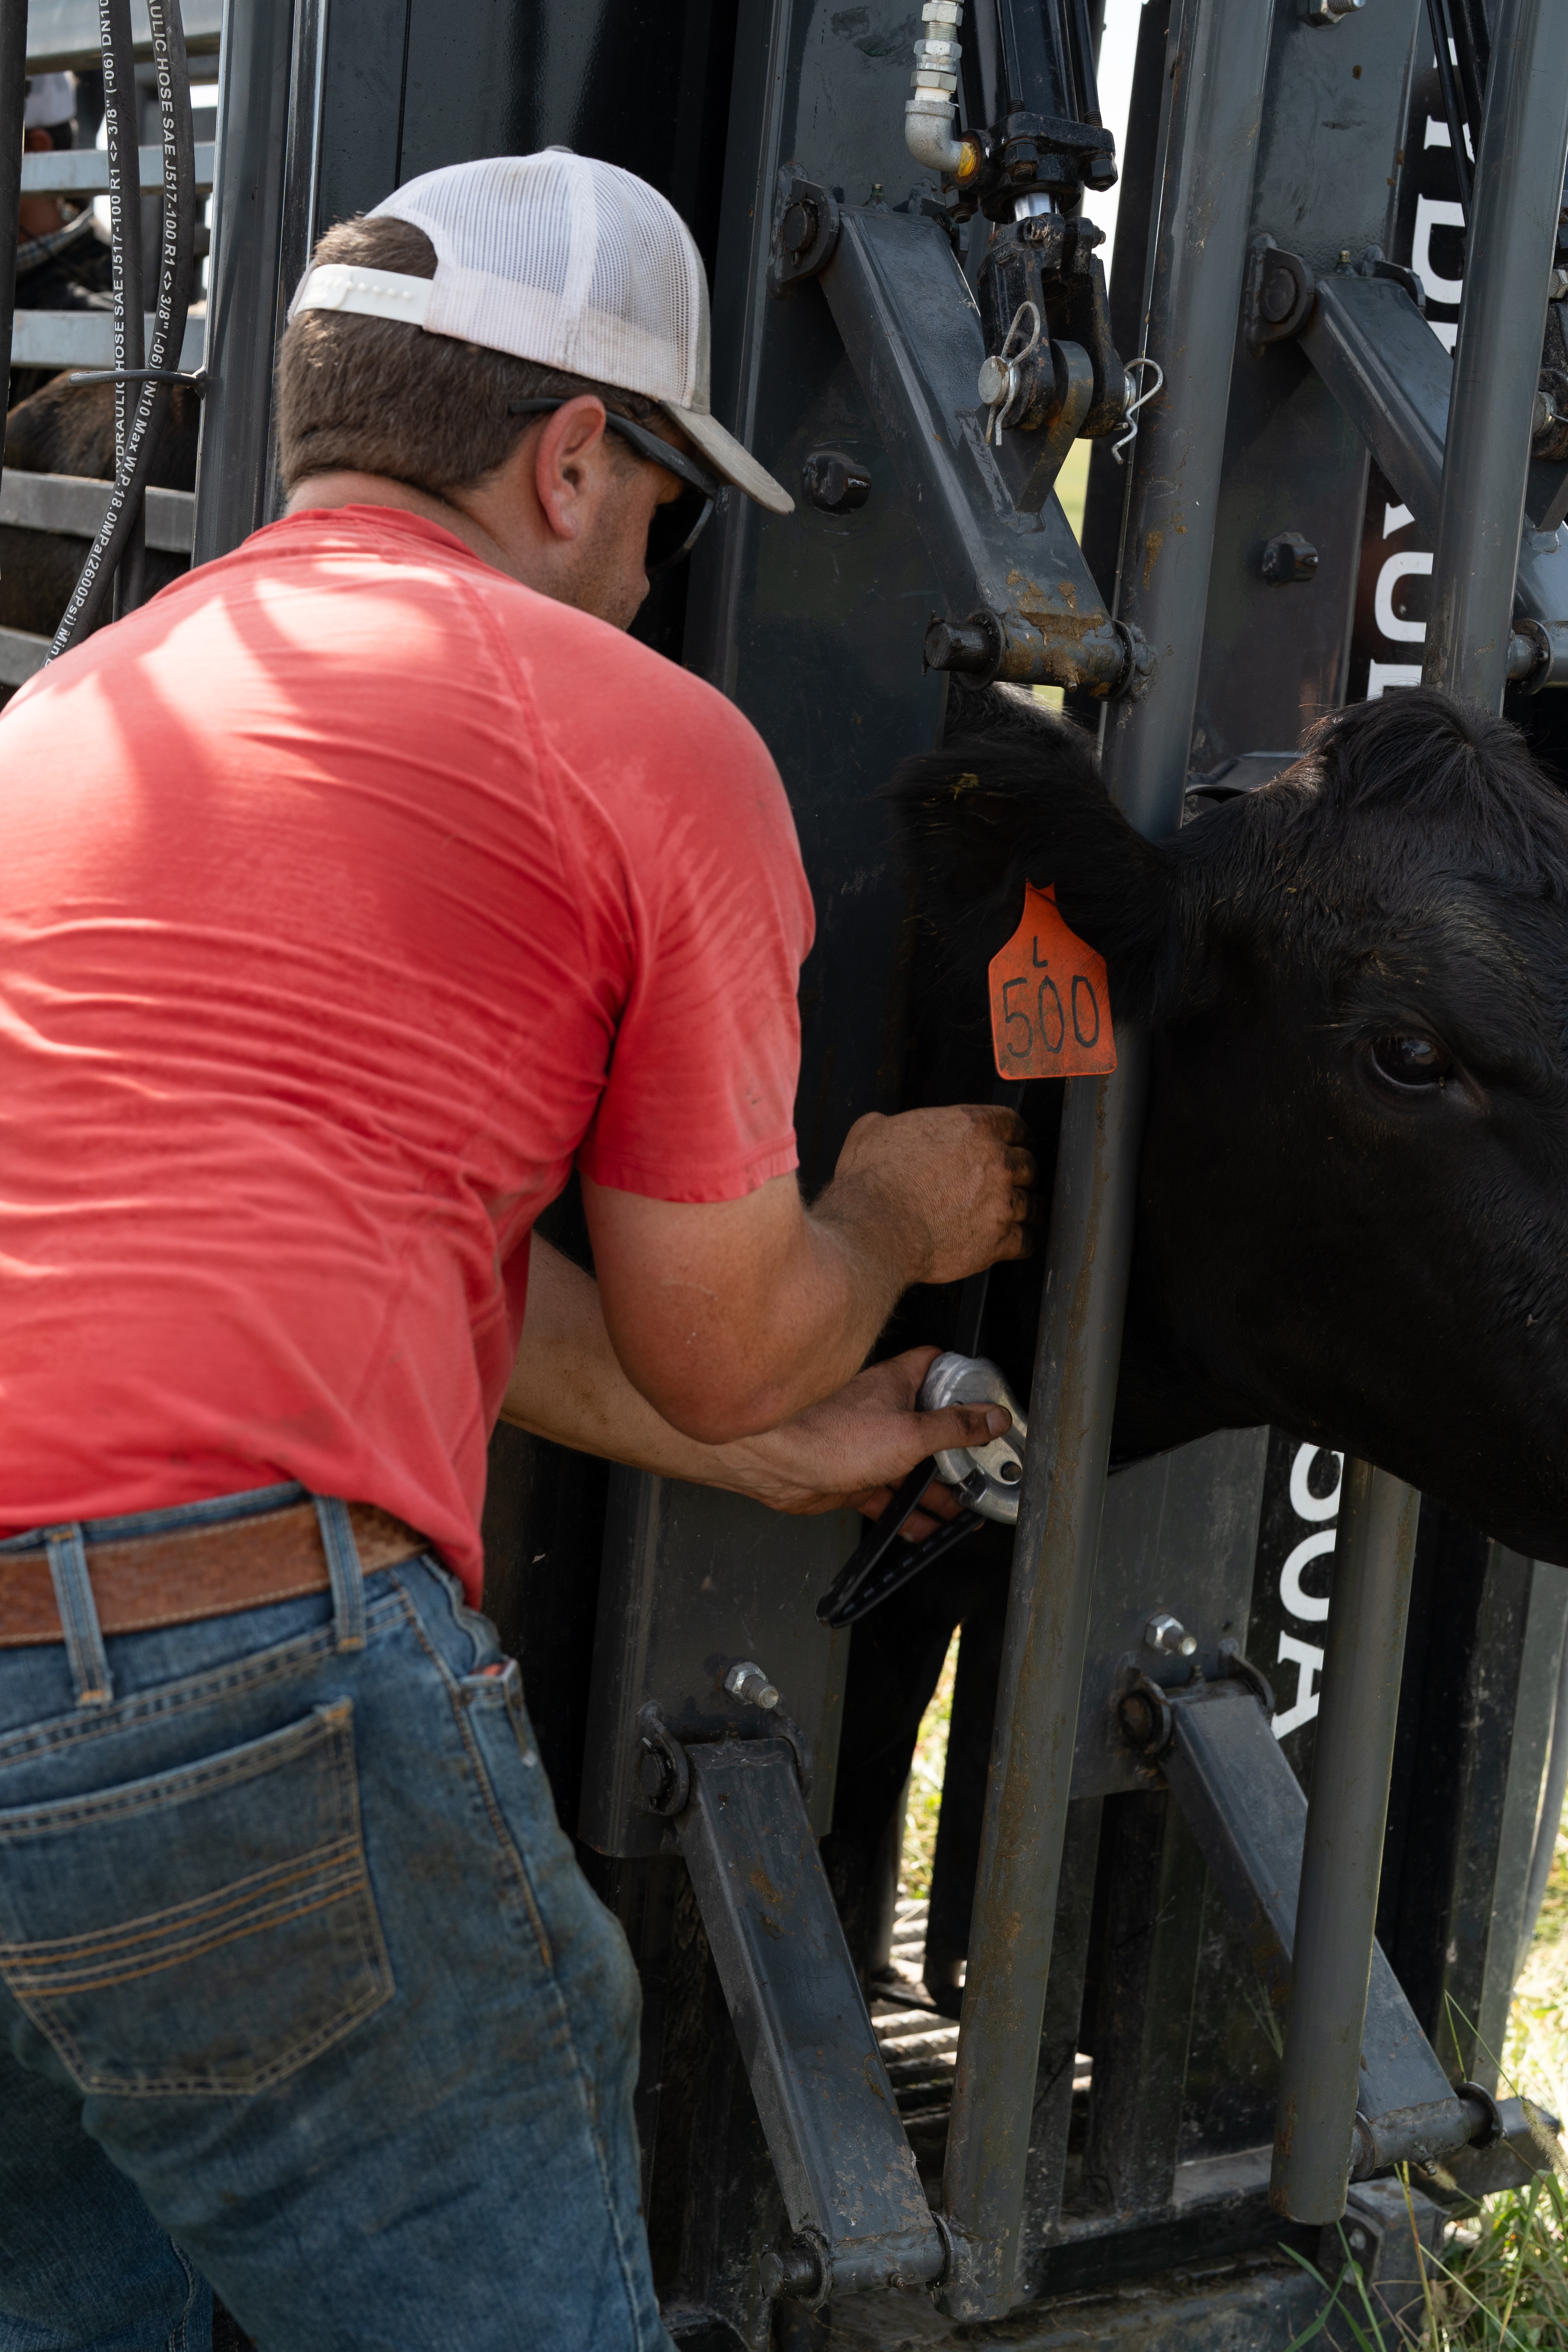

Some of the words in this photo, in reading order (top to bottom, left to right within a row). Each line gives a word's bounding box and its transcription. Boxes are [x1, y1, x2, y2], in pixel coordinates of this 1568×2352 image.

[99, 0, 111, 46] DN10
[103, 52, 117, 93] (-06)
[156, 58, 173, 112] HOSE
[106, 100, 118, 135] 3/8"
[163, 117, 175, 155] SAE
[110, 169, 120, 189] R1
[165, 160, 177, 239] J517-100
[111, 195, 123, 275] J517-100
[164, 244, 176, 265] R1
[114, 280, 124, 316] SAE
[159, 294, 171, 329] 3/8"
[115, 321, 125, 371] HOSE
[150, 332, 167, 369] (-06)
[129, 418, 147, 452] Max
[51, 627, 71, 655] Min
[1033, 935, 1048, 968] L
[1002, 975, 1100, 1059] 500
